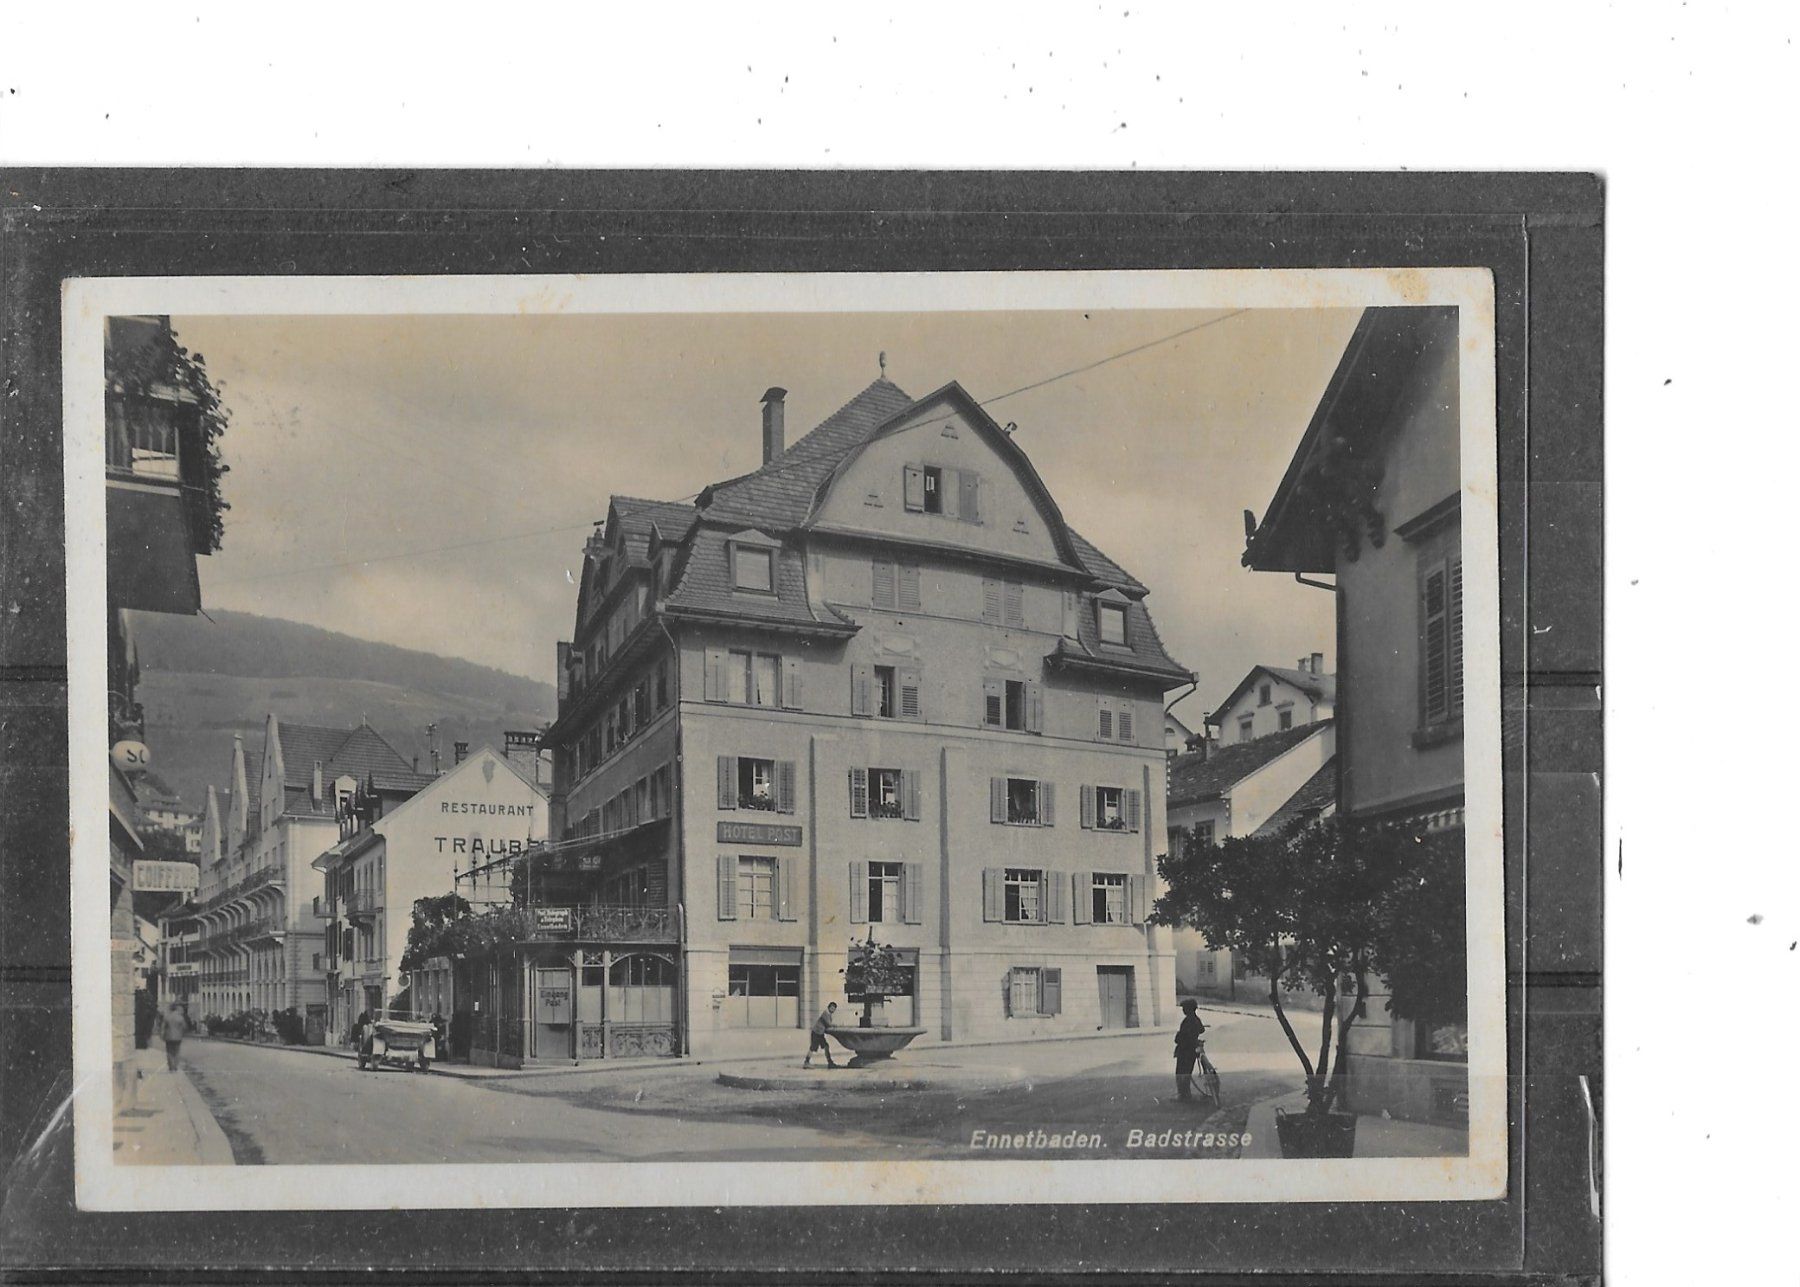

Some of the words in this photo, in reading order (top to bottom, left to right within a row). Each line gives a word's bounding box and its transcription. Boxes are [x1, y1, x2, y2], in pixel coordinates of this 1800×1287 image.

[441, 802, 534, 816] RESTAURANT
[723, 824, 764, 840] HOTEL
[768, 826, 798, 842] POST
